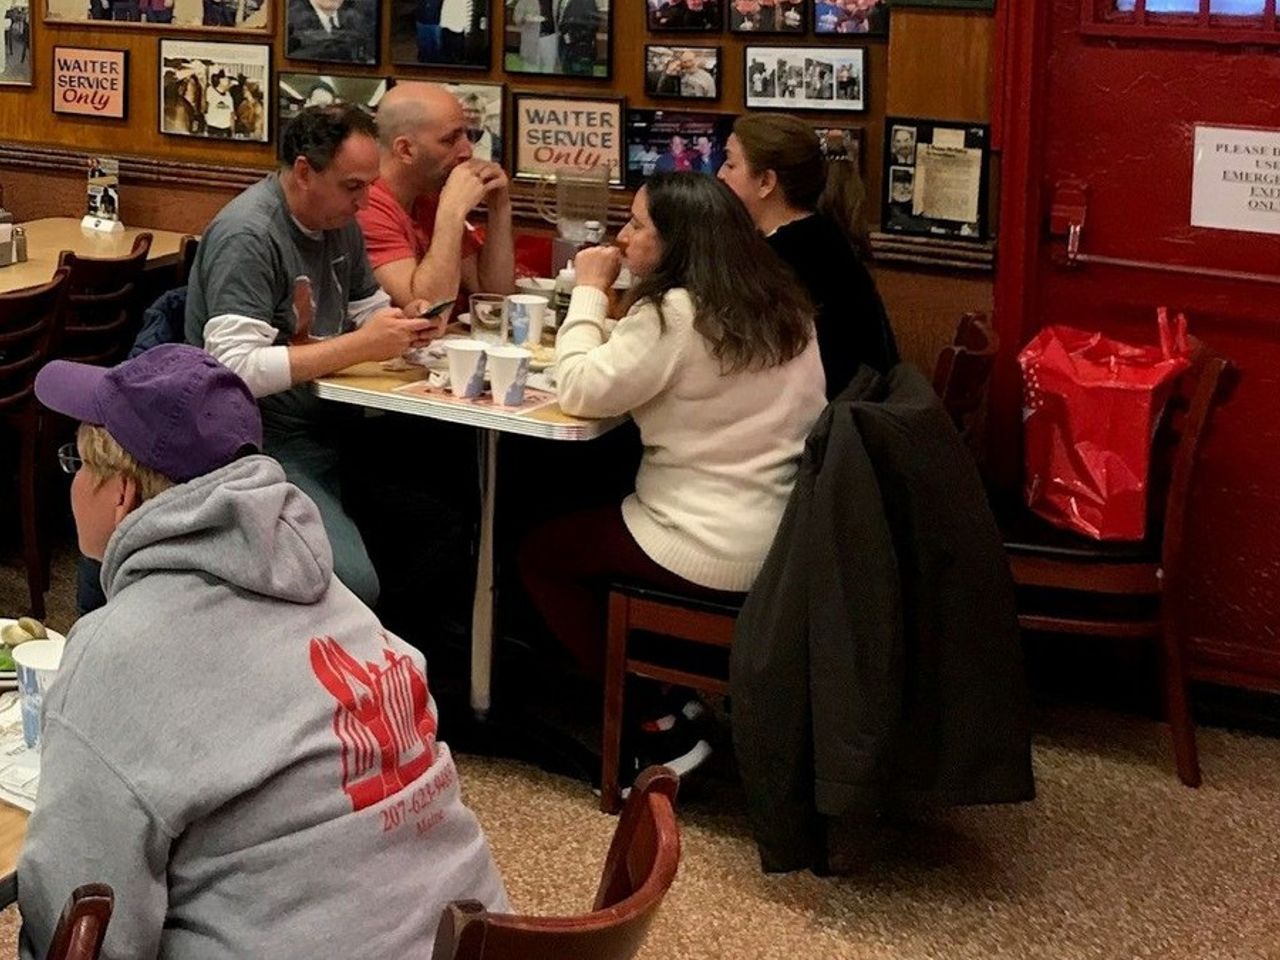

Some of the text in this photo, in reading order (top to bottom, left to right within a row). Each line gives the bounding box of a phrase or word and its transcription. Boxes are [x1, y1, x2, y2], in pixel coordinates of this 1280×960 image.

[57, 57, 120, 75] WAITER
[57, 74, 119, 91] SERVICE
[62, 87, 111, 111] Only
[525, 107, 614, 128] WAITER
[525, 127, 614, 149] SERVICE
[533, 145, 601, 172] Only
[1216, 143, 1265, 156] PLEASE
